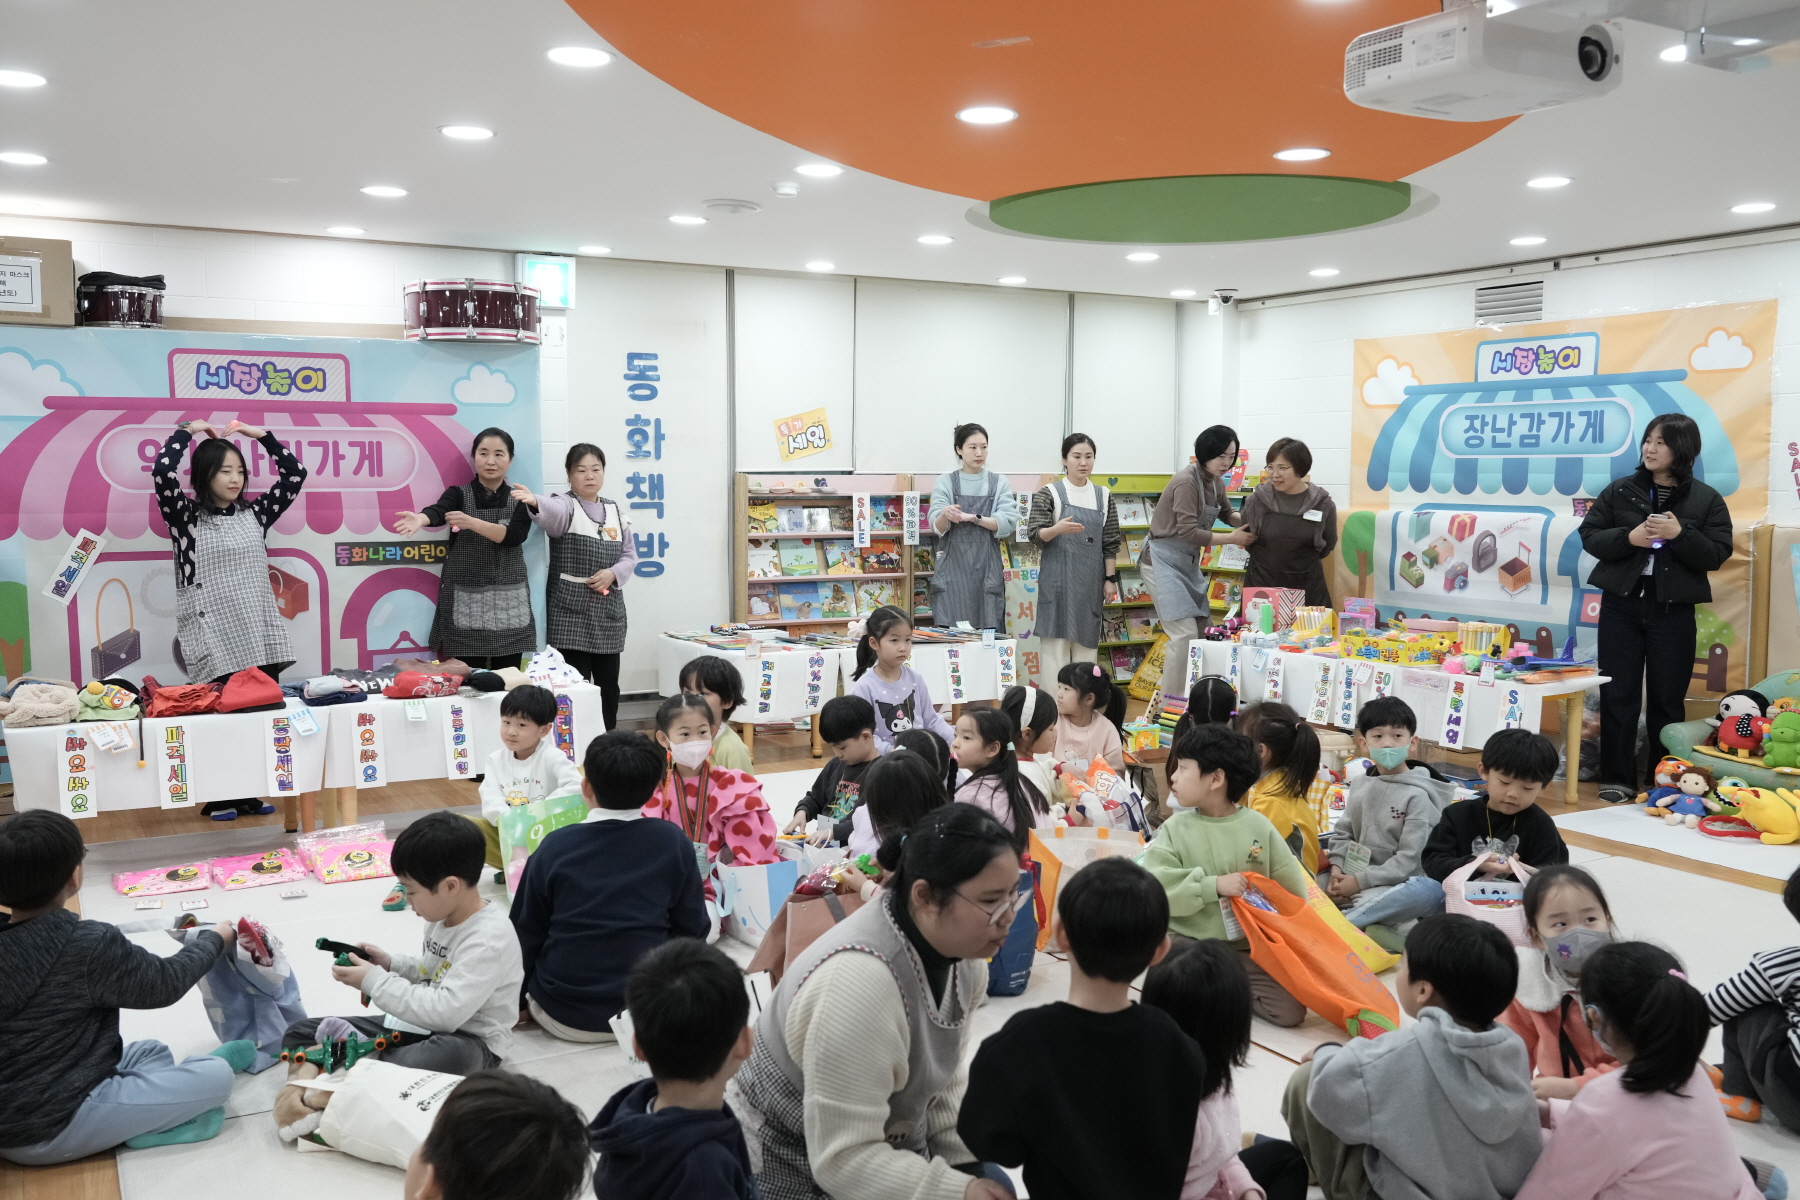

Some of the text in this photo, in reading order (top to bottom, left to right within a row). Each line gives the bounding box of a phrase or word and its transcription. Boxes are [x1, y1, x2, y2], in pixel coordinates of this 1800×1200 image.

[196, 360, 327, 396] 시장놀이
[1491, 345, 1581, 375] 시장놀이
[780, 419, 803, 435] 특가
[787, 424, 826, 454] 세일
[1463, 409, 1605, 449] 장난감가게
[623, 352, 670, 578] 동화책방
[857, 497, 866, 544] SALE
[52, 536, 97, 598] 파격세일
[759, 661, 775, 713] 재고정리
[1189, 647, 1202, 690] 50%세
[450, 705, 469, 775] 눈물의세일
[1446, 681, 1465, 745] 폭탄세일
[65, 737, 90, 813] 싸요싸요
[165, 726, 189, 803] 파격세일
[272, 718, 294, 791] 몽땅세일
[357, 713, 379, 783] 싸요싸요
